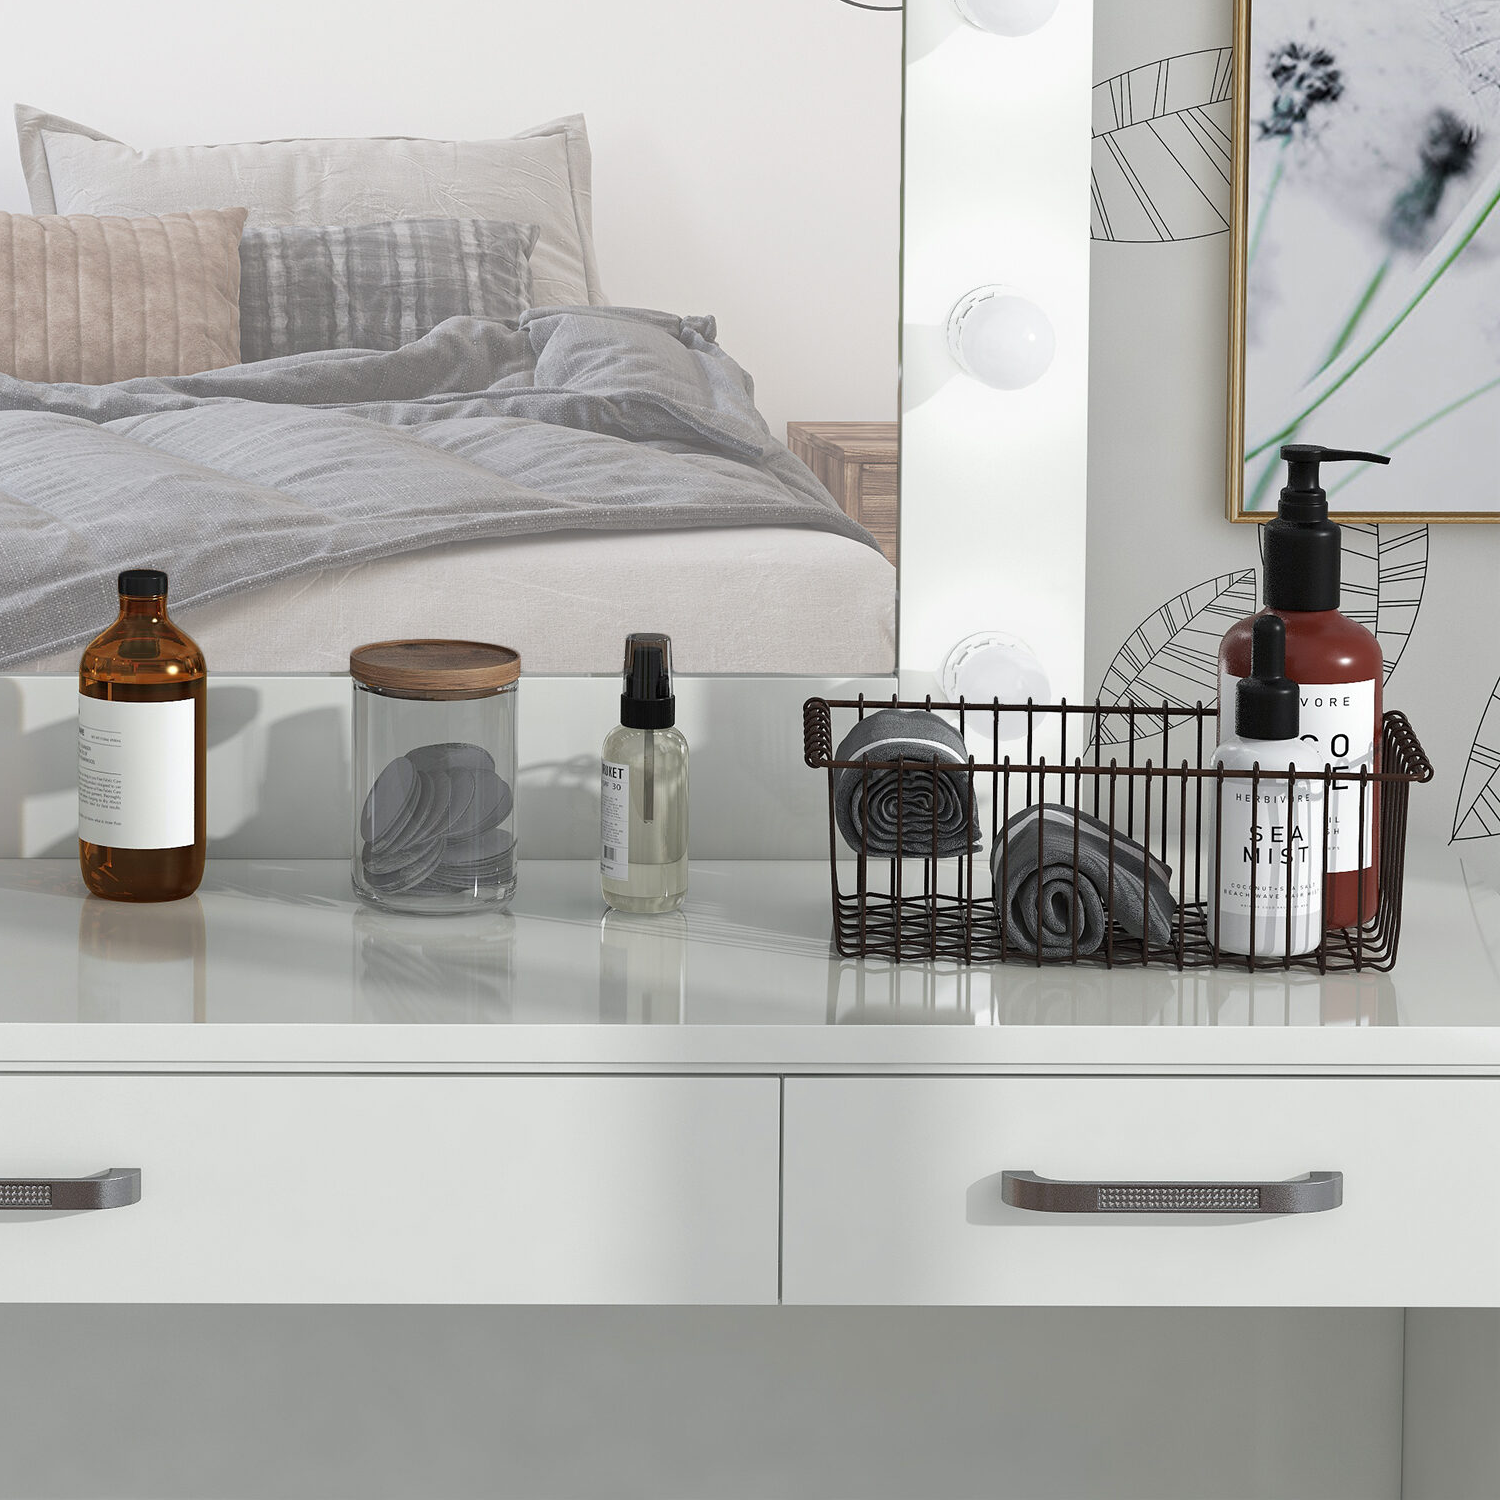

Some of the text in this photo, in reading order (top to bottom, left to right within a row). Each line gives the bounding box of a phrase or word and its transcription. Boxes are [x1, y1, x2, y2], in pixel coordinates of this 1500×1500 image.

[1235, 793, 1310, 804] HERBIVRE
[1249, 825, 1303, 843] SEA
[1243, 846, 1309, 864] MIST
